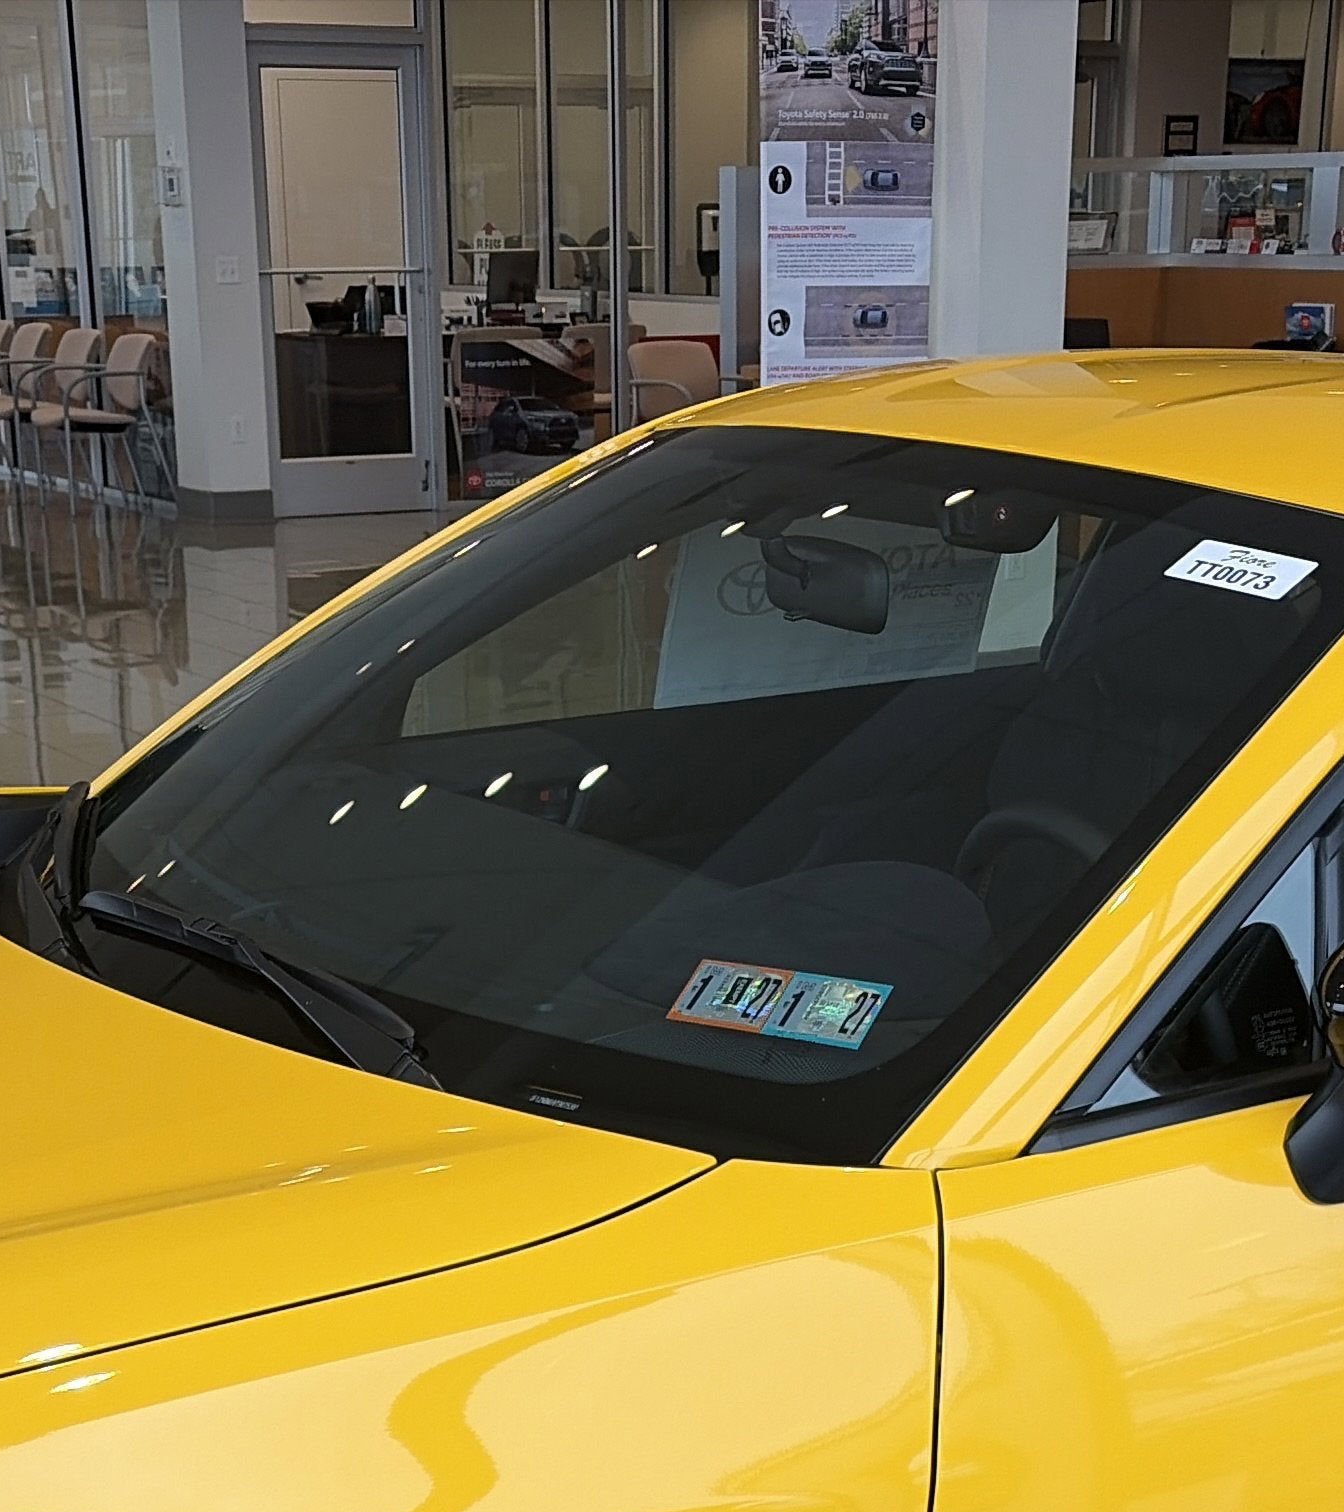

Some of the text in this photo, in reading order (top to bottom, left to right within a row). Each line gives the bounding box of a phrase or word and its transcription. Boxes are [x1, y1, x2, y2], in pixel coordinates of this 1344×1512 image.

[778, 109, 802, 120] Toyota
[804, 110, 827, 120] Safety
[853, 111, 864, 119] 2.0
[1186, 559, 1277, 590] TT0073
[1221, 549, 1276, 569] Fiore
[686, 974, 714, 1010] 1
[741, 977, 783, 1020] 27
[777, 990, 806, 1027] 1
[838, 991, 881, 1036] 27
